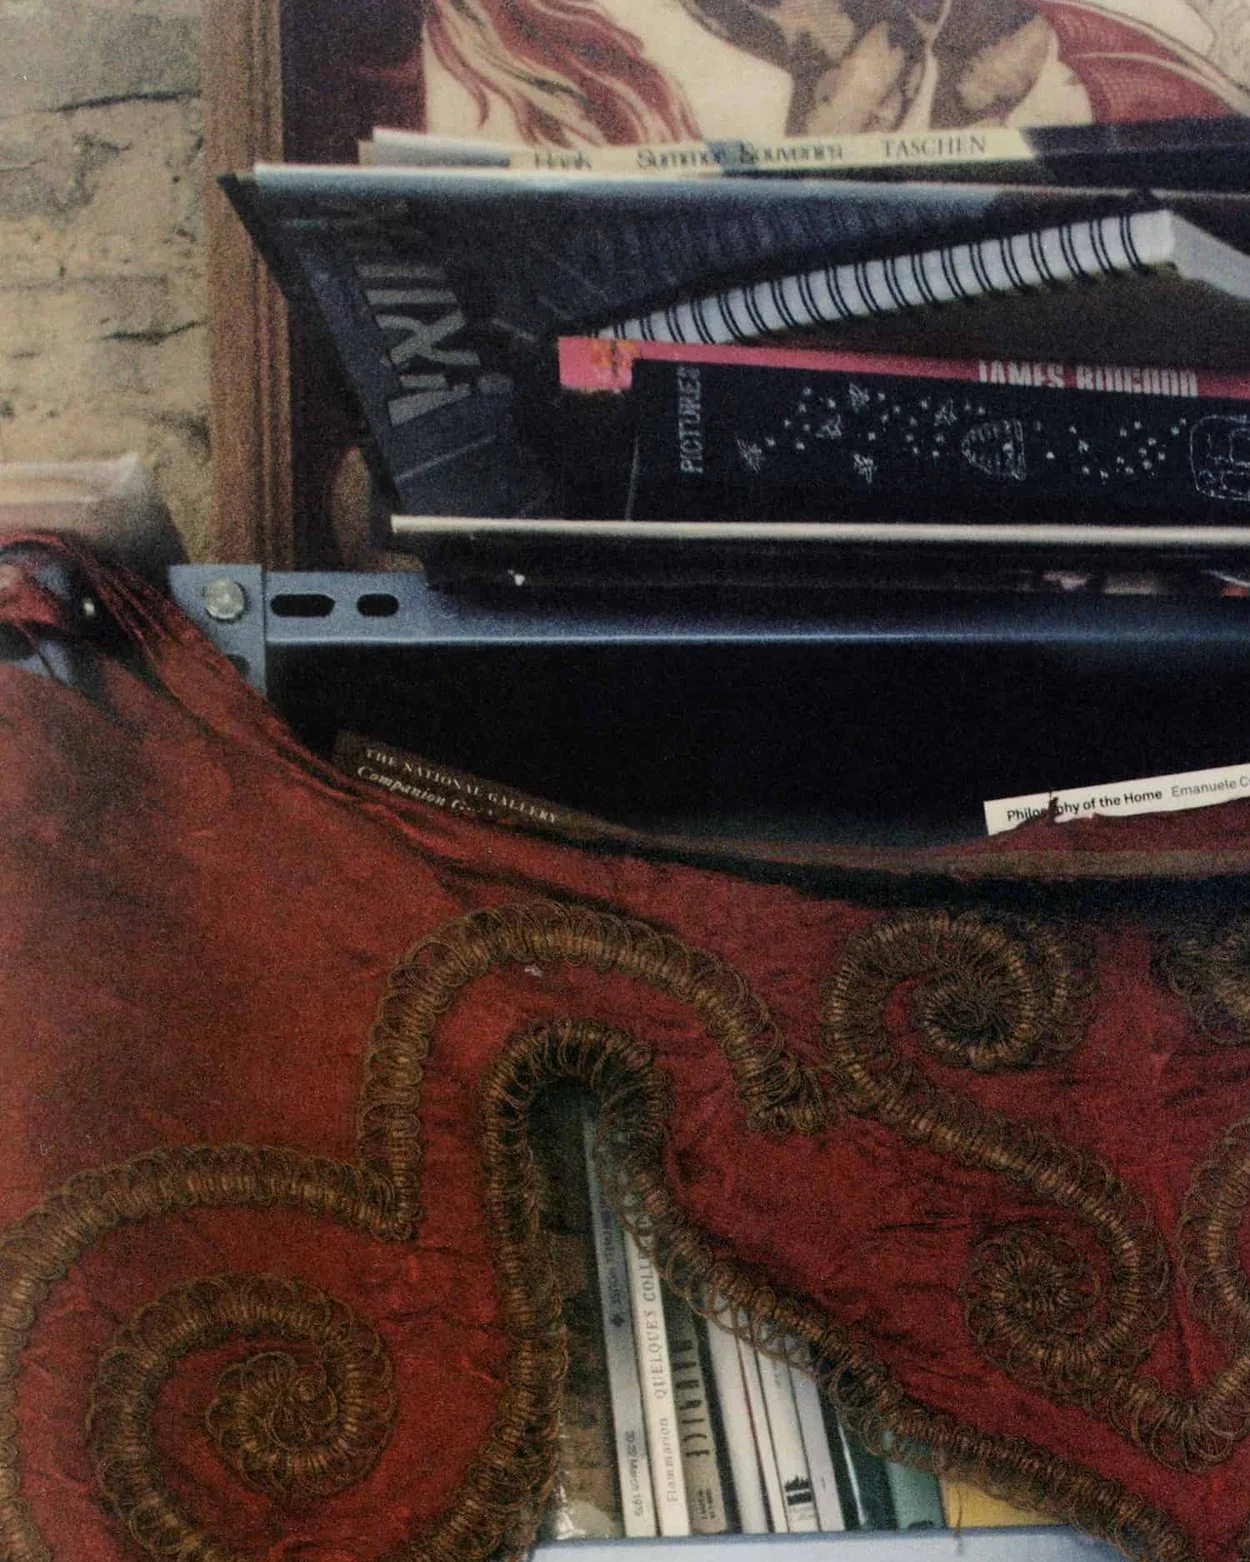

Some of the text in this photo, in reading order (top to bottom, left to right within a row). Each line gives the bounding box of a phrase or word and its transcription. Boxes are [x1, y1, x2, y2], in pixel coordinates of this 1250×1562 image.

[881, 135, 987, 158] TASCHEN
[357, 766, 446, 806] Companion
[366, 749, 397, 768] THE
[404, 762, 480, 796] NATIONAL
[488, 792, 556, 824] GALLERY
[1083, 788, 1162, 811] of the Home
[1170, 779, 1238, 799] Emanuele
[646, 1307, 667, 1402] QUELQUES
[661, 1417, 681, 1504] Flammarion
